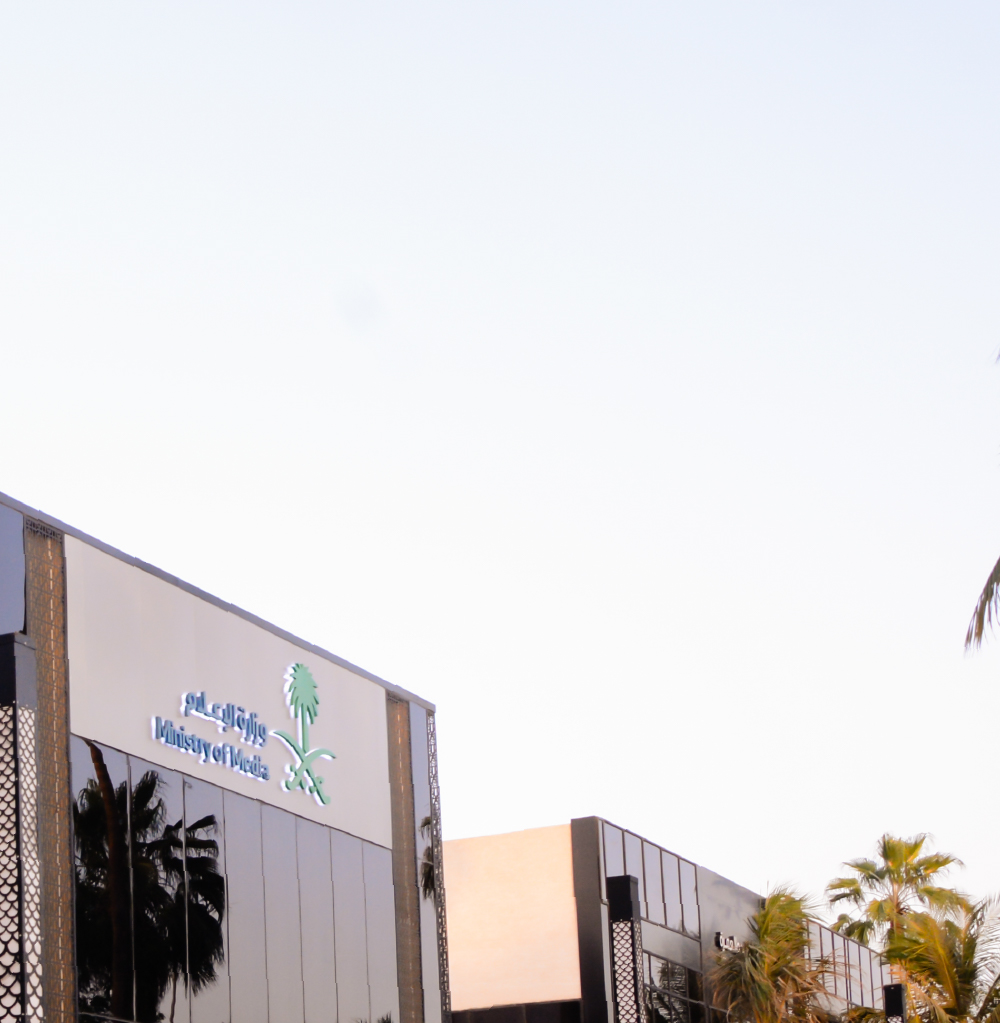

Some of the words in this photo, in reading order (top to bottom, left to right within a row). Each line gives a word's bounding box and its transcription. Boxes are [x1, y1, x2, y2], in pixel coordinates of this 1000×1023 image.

[154, 716, 211, 763] Ministry
[212, 743, 230, 764] of
[230, 745, 270, 780] Media
[236, 706, 268, 747] وزارة
